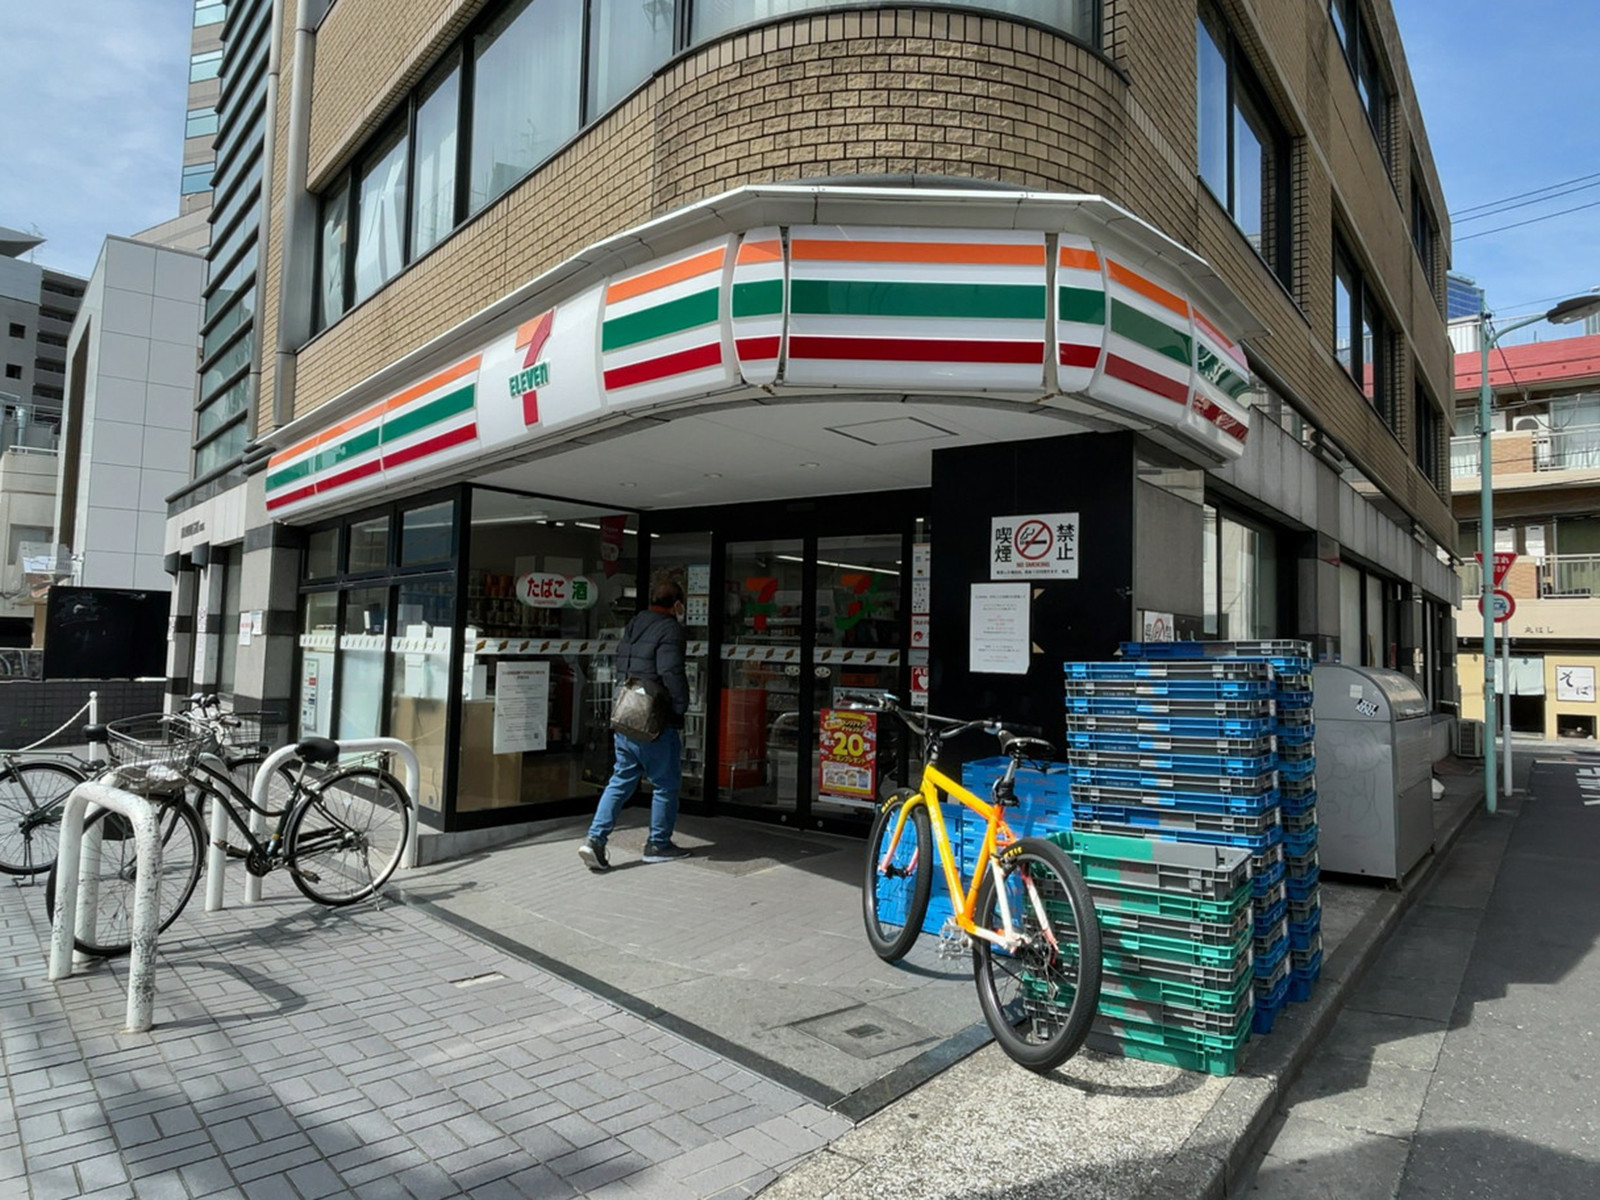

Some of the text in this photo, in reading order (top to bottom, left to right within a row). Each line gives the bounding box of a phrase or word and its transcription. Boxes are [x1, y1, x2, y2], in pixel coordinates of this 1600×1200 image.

[515, 307, 555, 425] 7
[994, 527, 1013, 563] 喫煙
[1056, 523, 1075, 561] 禁止
[527, 577, 565, 599] たばこ
[572, 580, 588, 601] 酒
[1559, 670, 1592, 696] そば
[833, 731, 865, 757] 20
